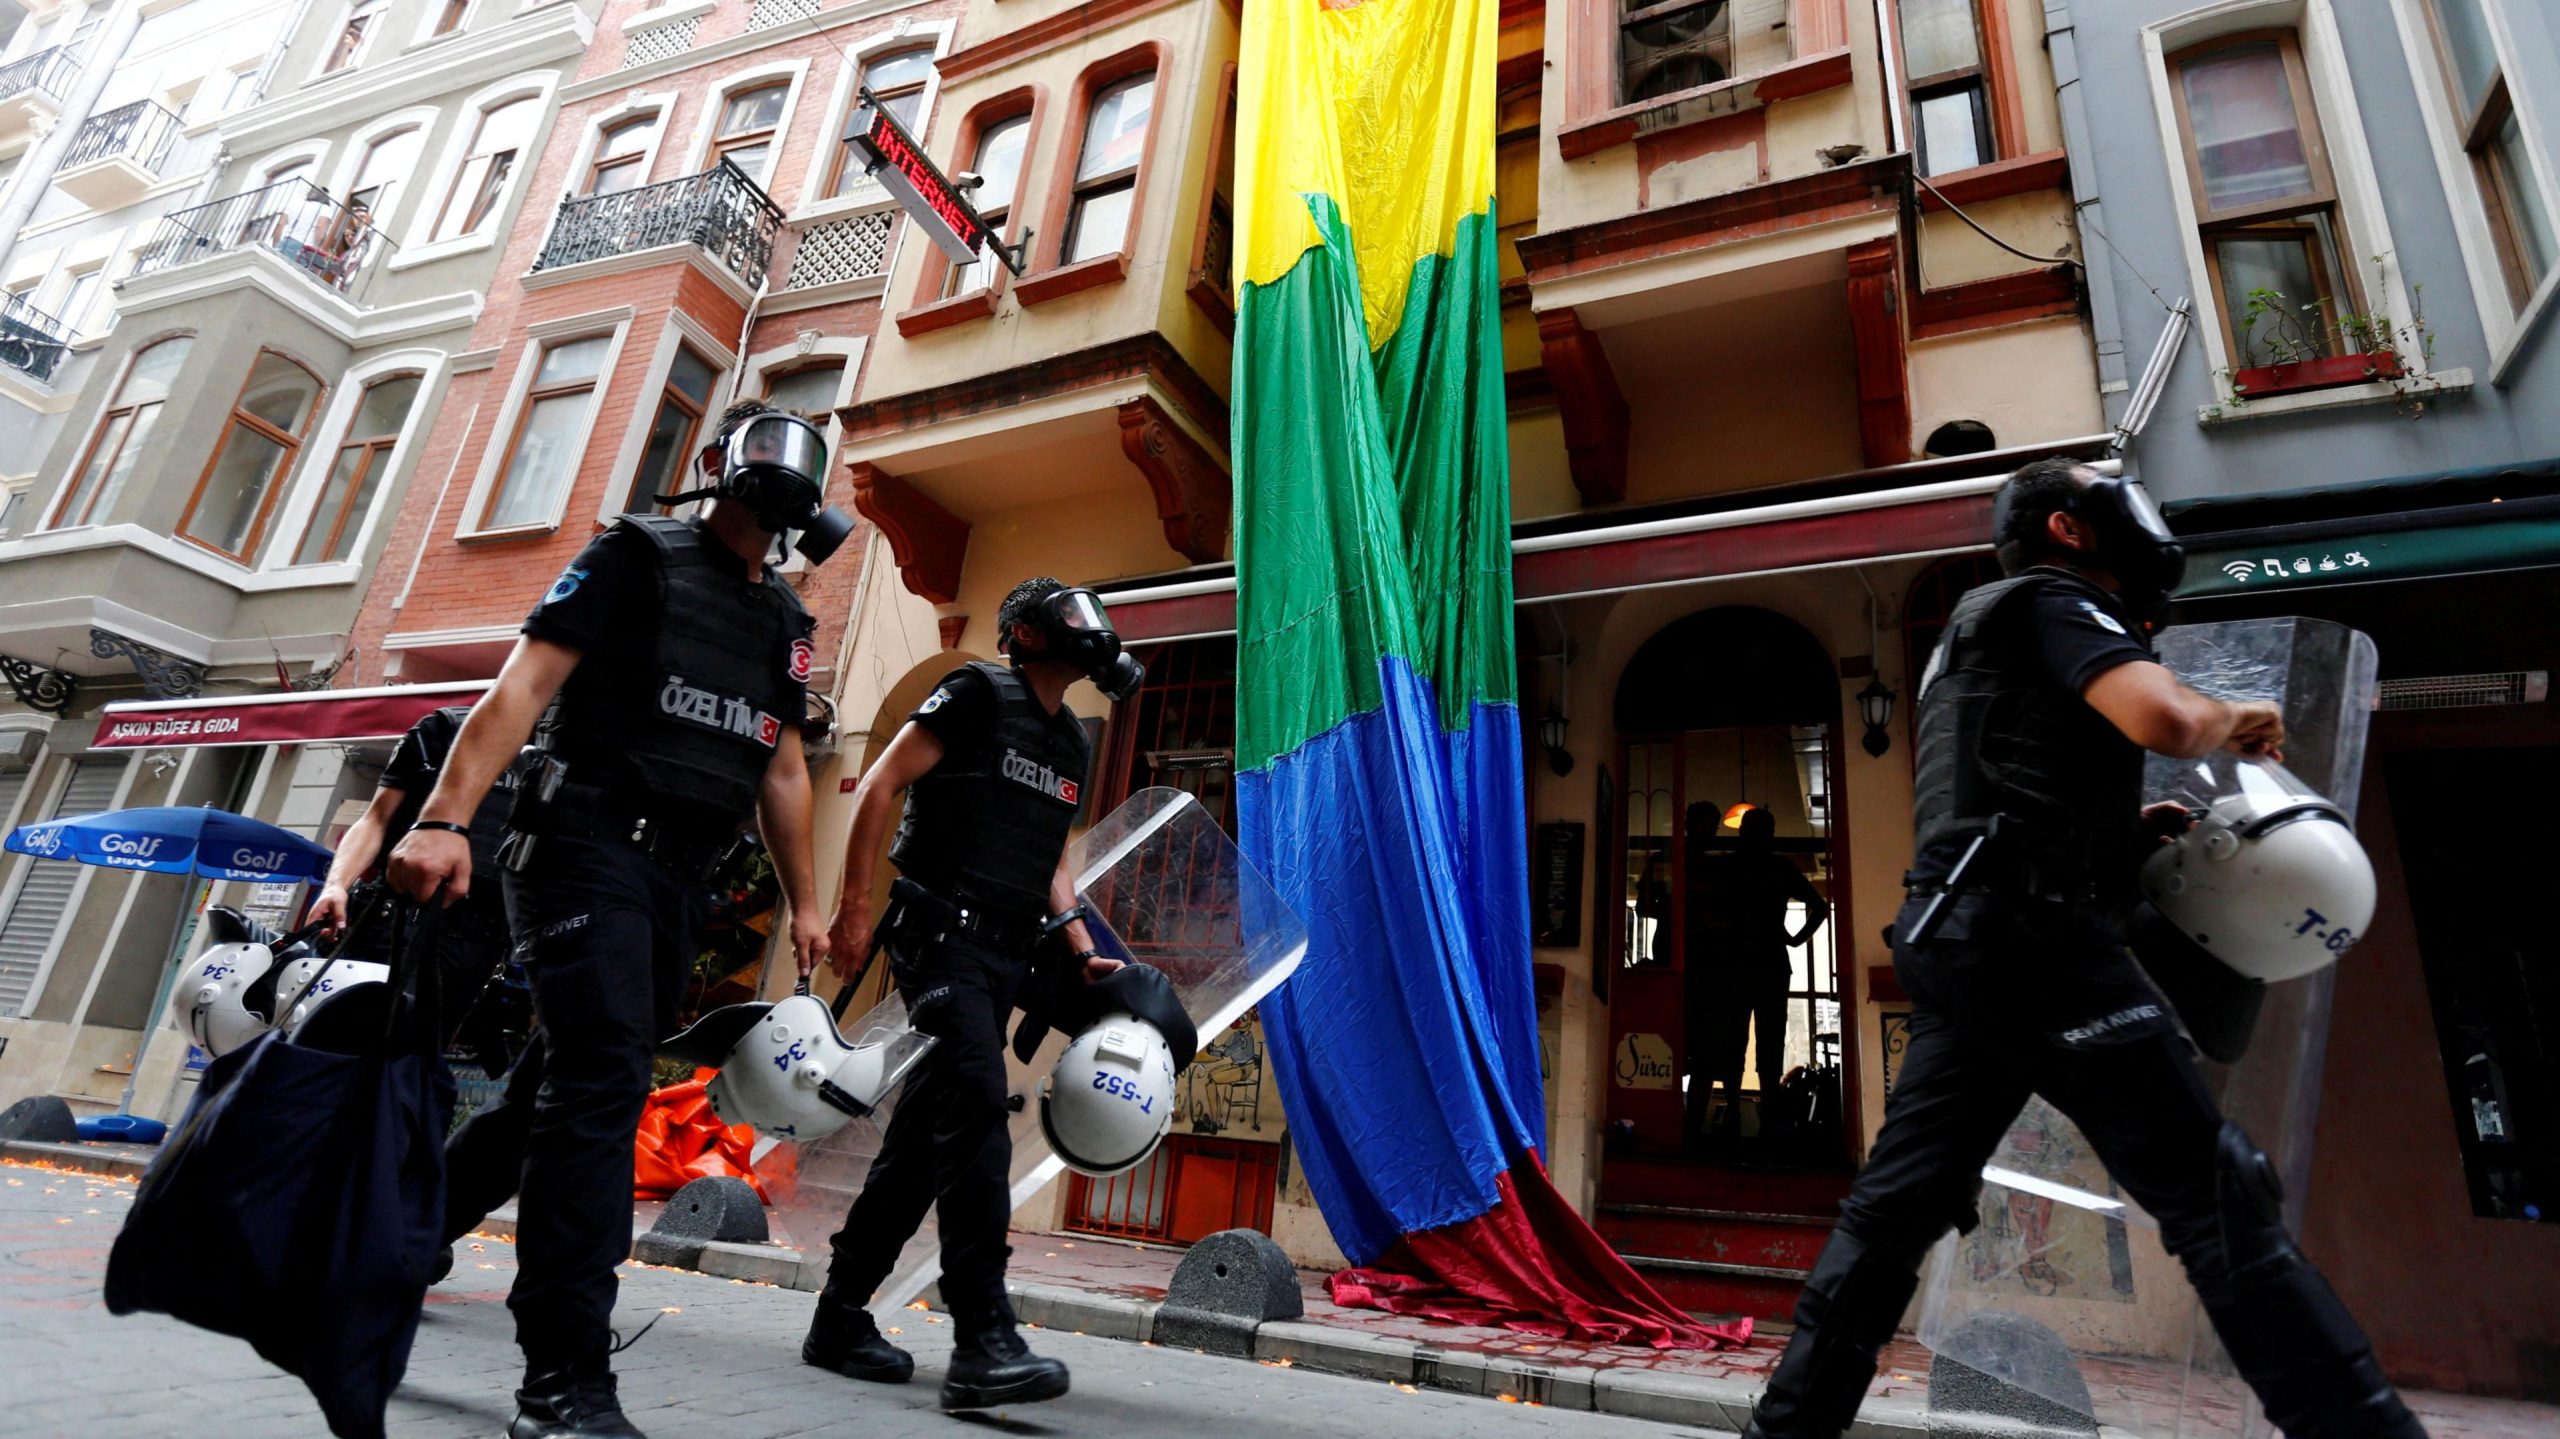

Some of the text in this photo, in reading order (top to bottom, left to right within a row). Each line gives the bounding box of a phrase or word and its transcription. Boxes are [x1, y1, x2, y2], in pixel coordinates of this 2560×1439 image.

[109, 717, 240, 740] AŞKIN BÜFE & GIDA
[100, 833, 163, 857] Golf
[233, 848, 288, 871] Golf
[1092, 1070, 1153, 1114] T-552
